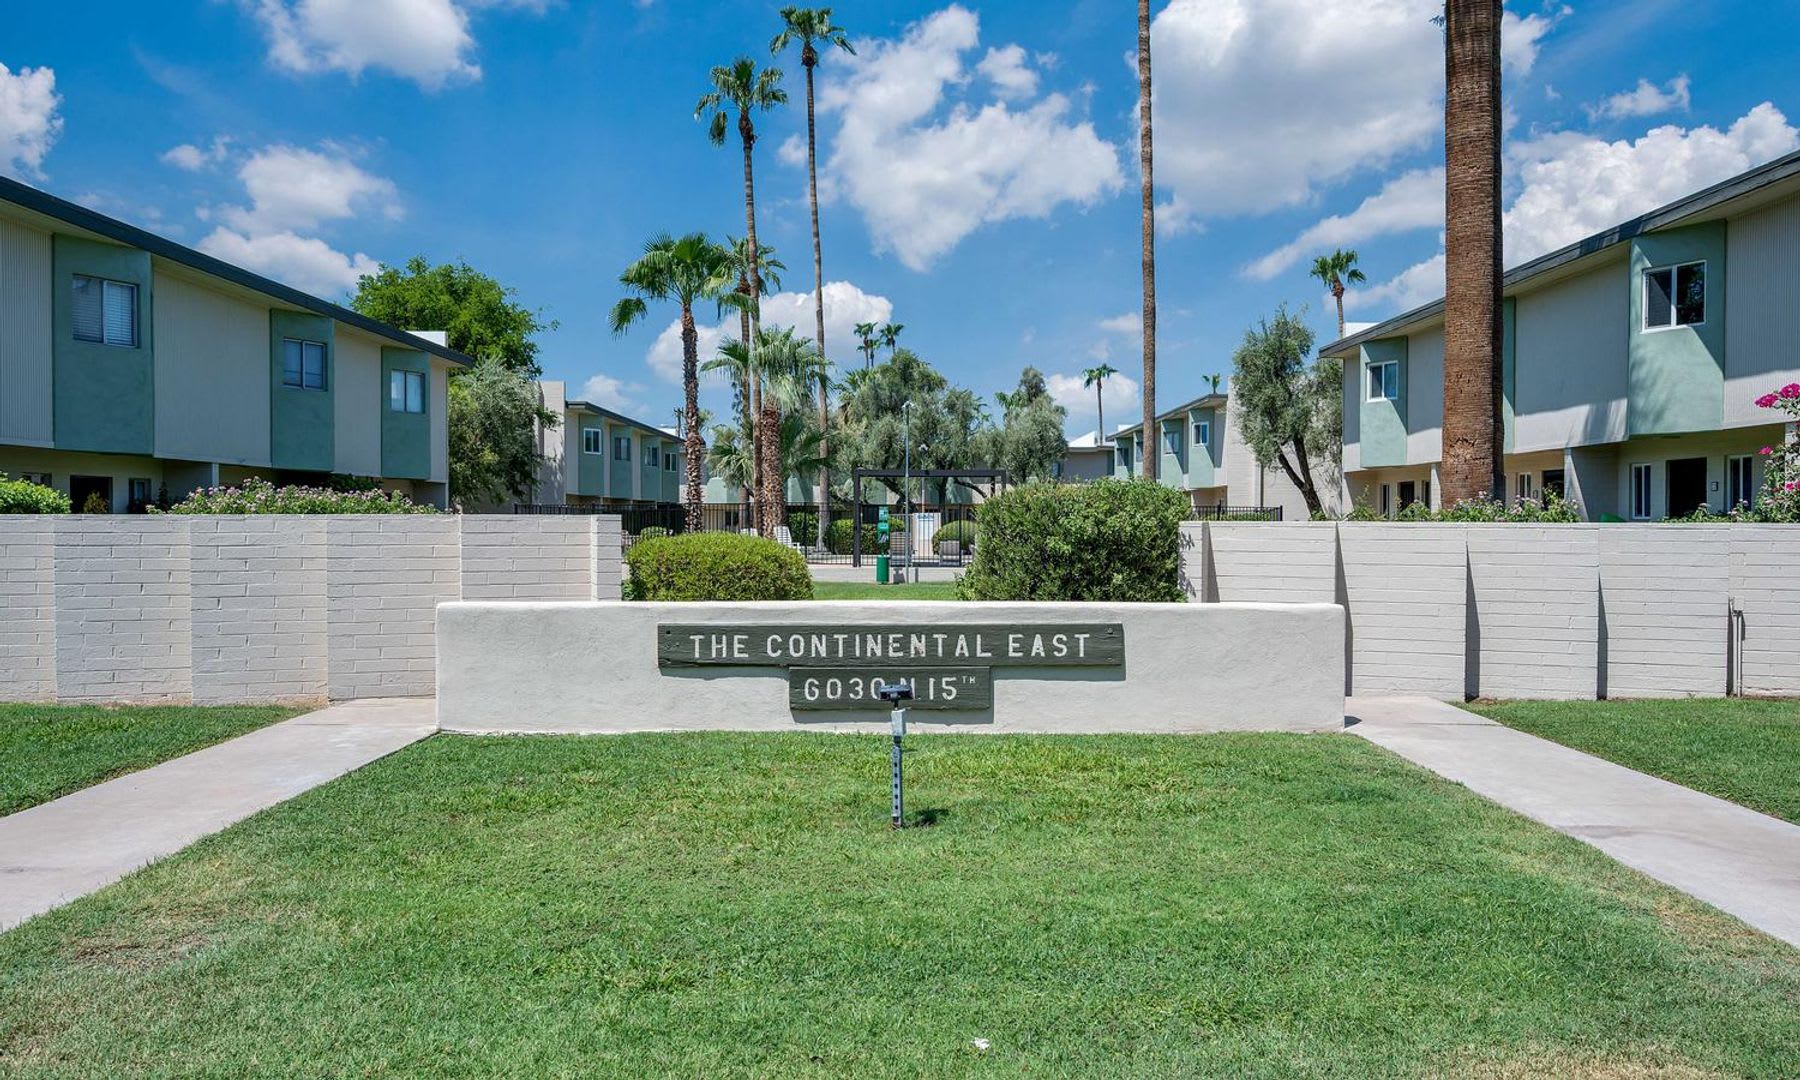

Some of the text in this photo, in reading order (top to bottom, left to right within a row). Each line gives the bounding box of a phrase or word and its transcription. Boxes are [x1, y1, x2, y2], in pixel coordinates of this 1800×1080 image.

[689, 634, 1090, 658] THE CONTINENTAL EAST
